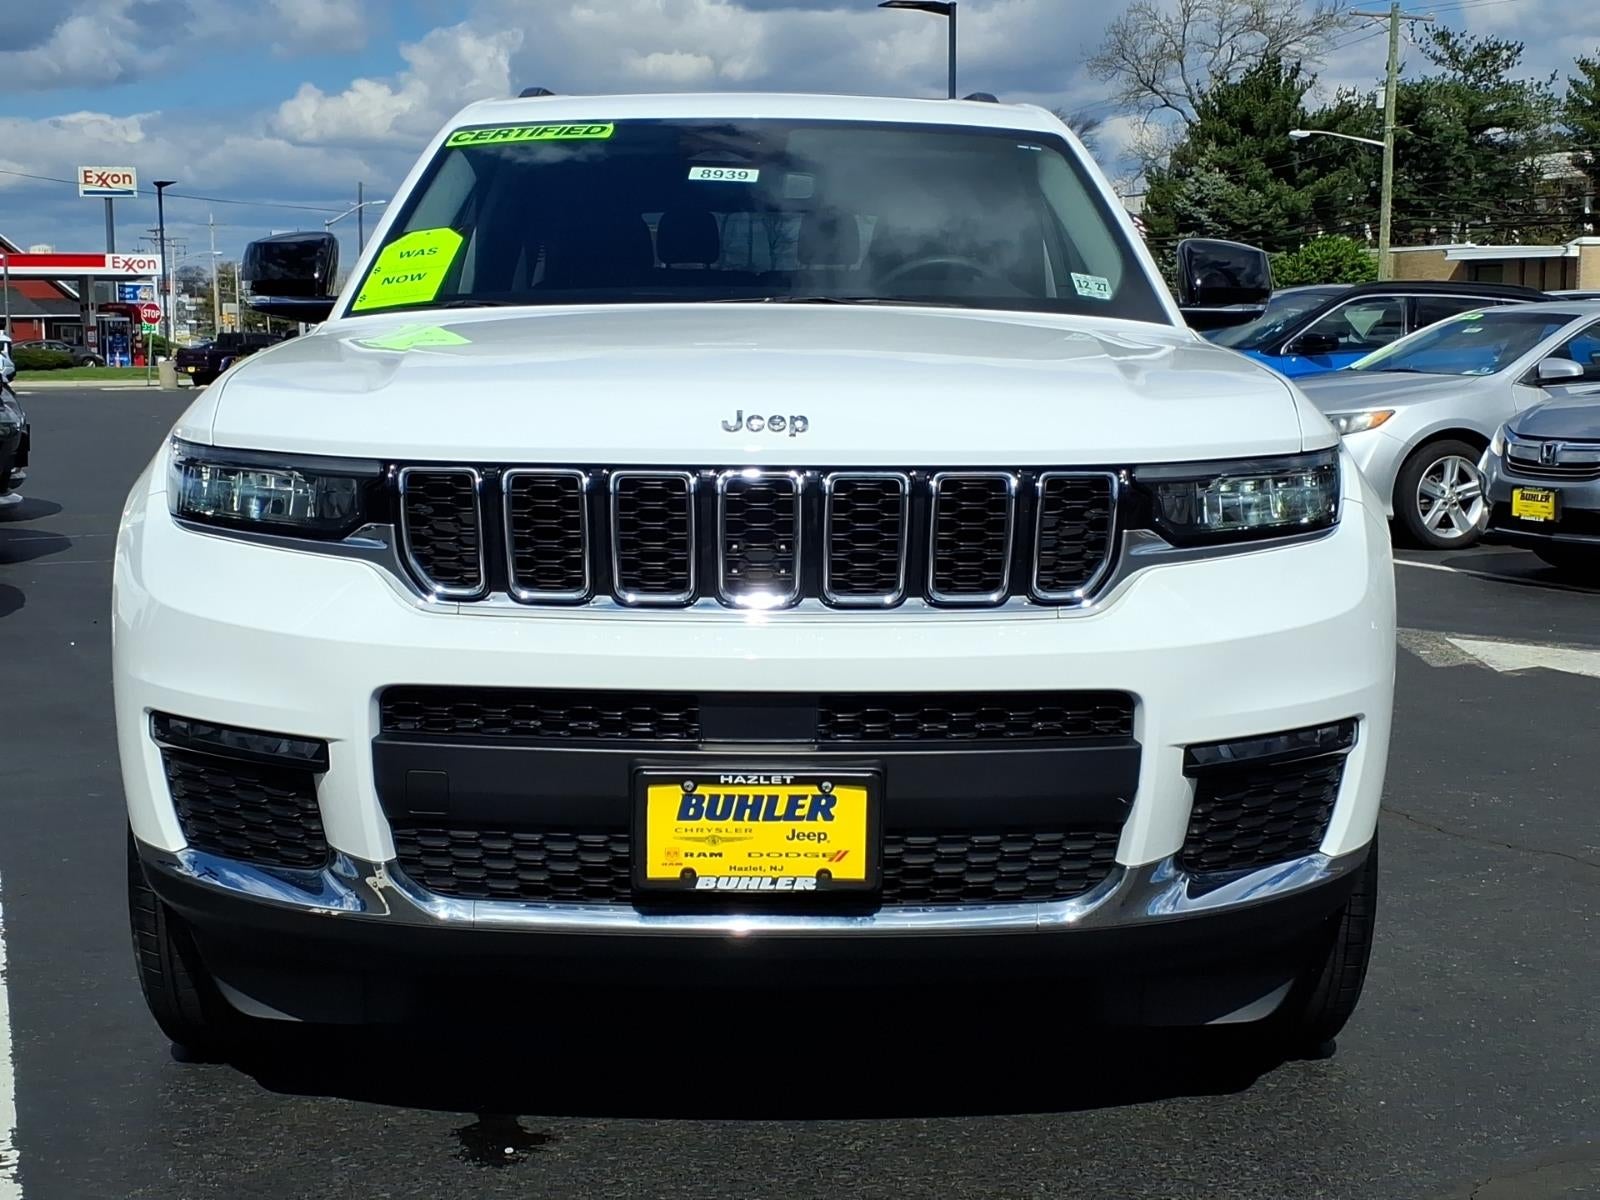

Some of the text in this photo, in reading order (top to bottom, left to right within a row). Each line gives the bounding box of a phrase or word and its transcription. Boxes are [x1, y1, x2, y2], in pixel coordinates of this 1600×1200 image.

[451, 125, 607, 144] CERTIFIED
[83, 170, 132, 188] Exxon
[700, 168, 749, 180] 8939
[399, 247, 438, 259] WAS
[112, 256, 156, 273] Exxon
[381, 272, 428, 286] NOW
[1076, 279, 1107, 292] 12 27
[143, 309, 160, 319] STOP
[721, 409, 809, 437] Jeep
[720, 775, 795, 784] HAZLET
[676, 793, 837, 822] BUHLER
[786, 828, 828, 843] Jeep
[695, 876, 817, 890] BUHLER
